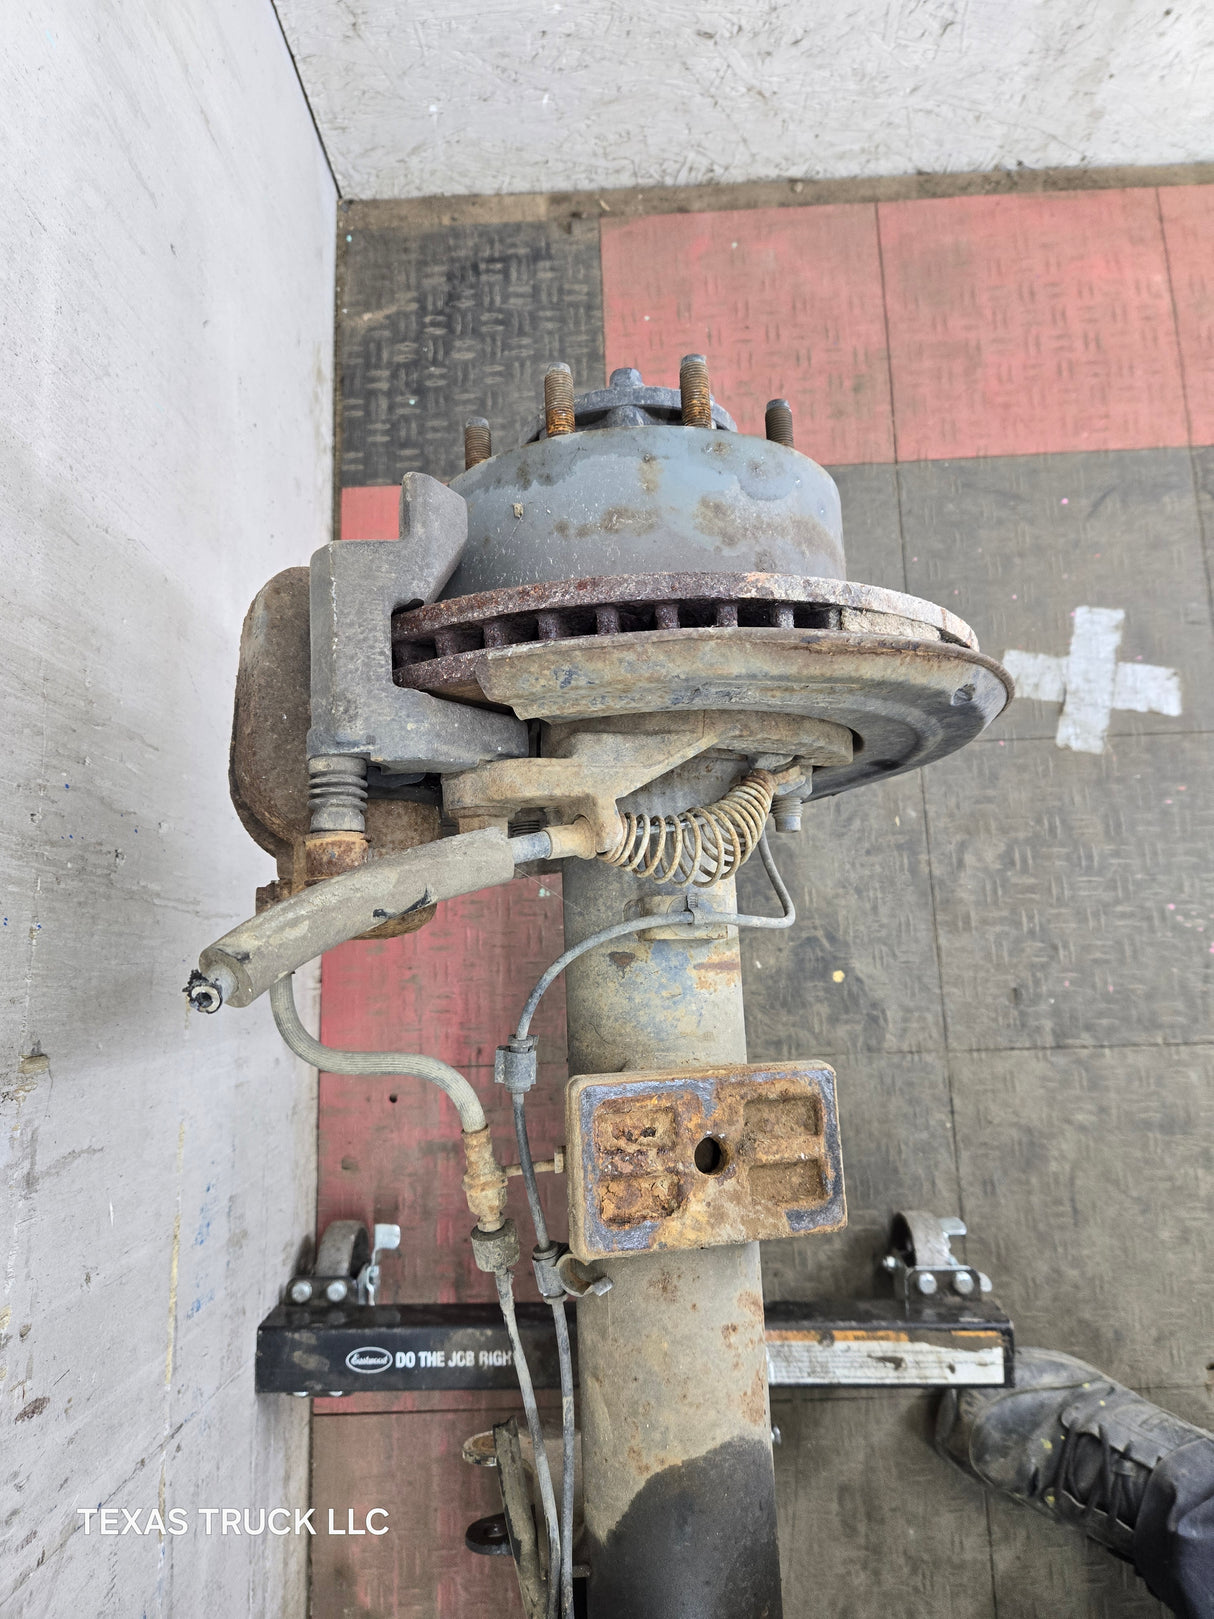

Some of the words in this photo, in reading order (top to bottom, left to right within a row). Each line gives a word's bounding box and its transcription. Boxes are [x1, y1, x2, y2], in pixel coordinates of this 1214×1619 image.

[350, 1353, 389, 1366] Eastwood
[395, 1351, 416, 1369] DO
[418, 1350, 445, 1368] THE
[448, 1350, 475, 1368] JOB
[479, 1350, 513, 1367] RIGH
